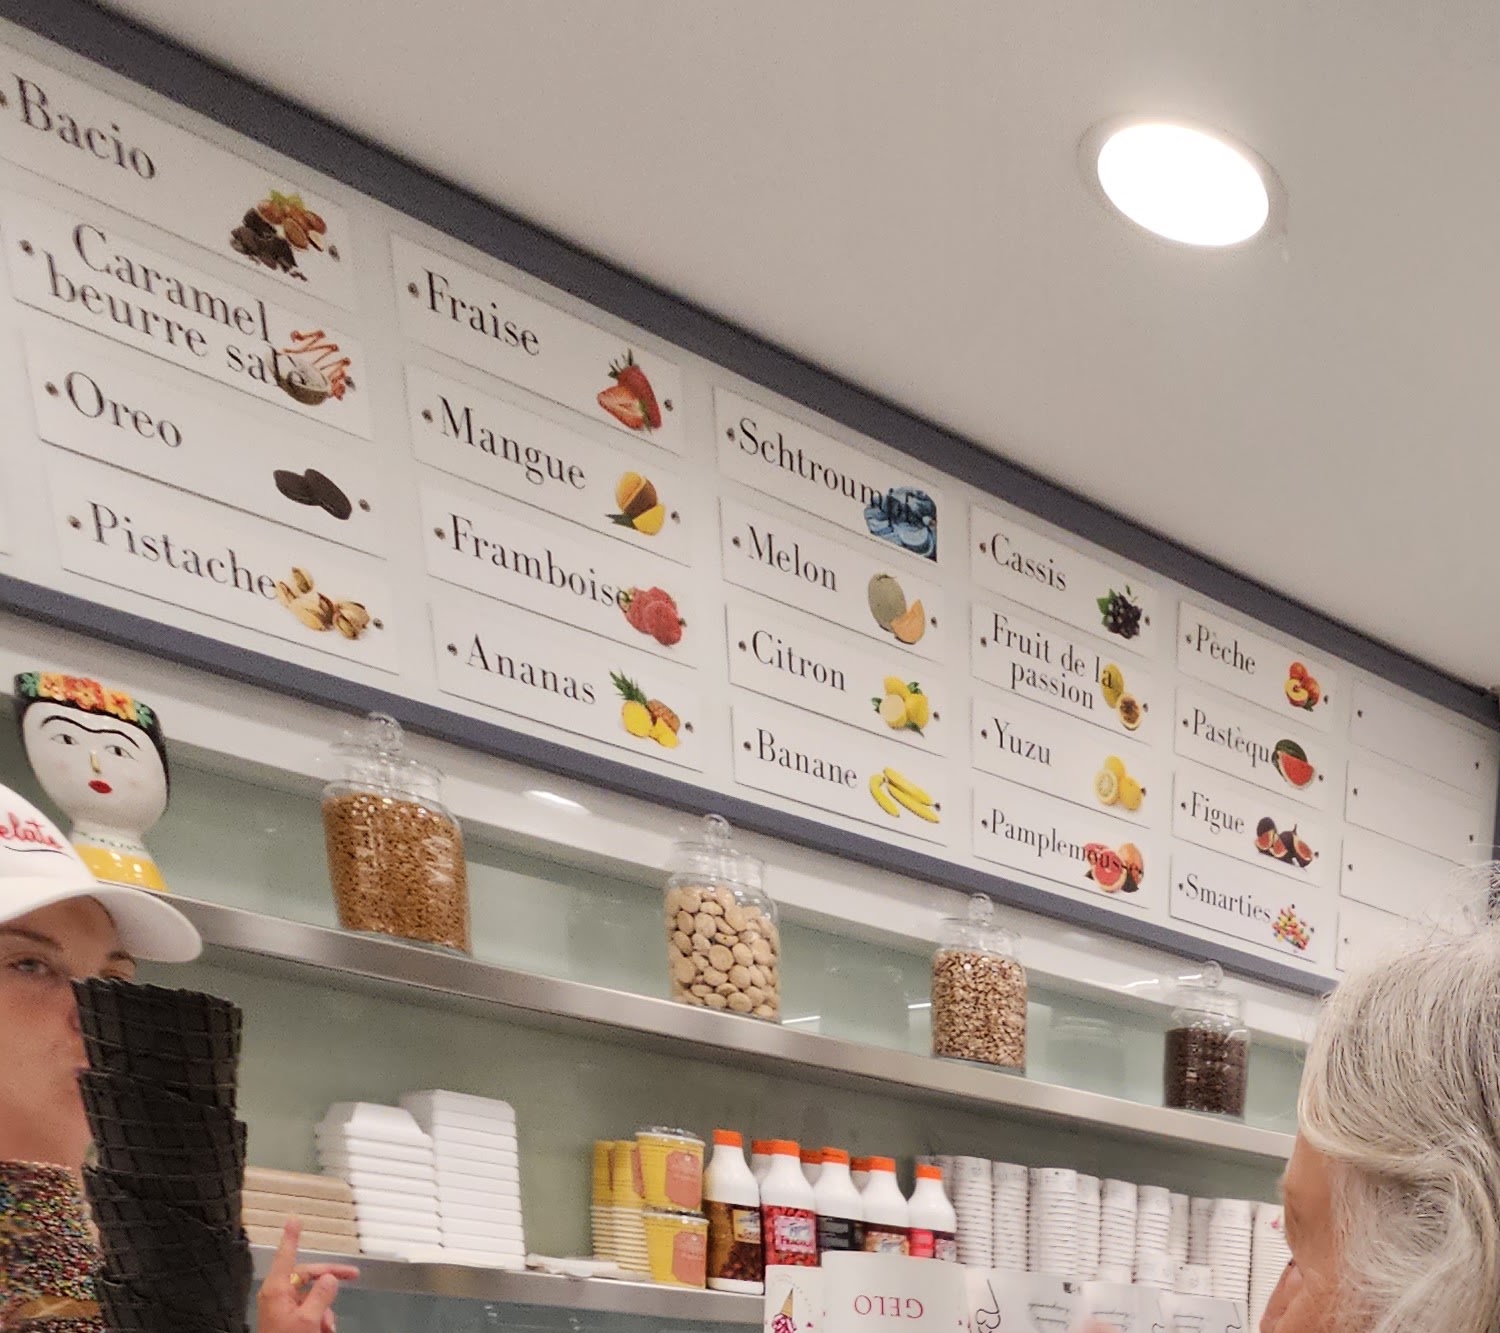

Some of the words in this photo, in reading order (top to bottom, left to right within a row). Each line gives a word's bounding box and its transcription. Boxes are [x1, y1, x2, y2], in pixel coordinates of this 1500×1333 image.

[11, 72, 156, 181] Bacio
[45, 249, 208, 357] beurre
[72, 223, 270, 341] Caramel
[422, 267, 540, 356] Fraise
[64, 371, 183, 448] Oreo
[437, 395, 586, 490] Mangue
[87, 500, 279, 600] Pistache
[449, 512, 632, 612] Framboise
[747, 524, 838, 592] Melon
[991, 533, 1067, 592] Cassis
[465, 633, 597, 705] Ananas
[752, 630, 847, 692] Citron
[993, 612, 1052, 664] Fruit
[1061, 645, 1085, 677] de
[1095, 656, 1113, 690] la
[1011, 661, 1095, 711] passion
[756, 728, 858, 789] Banane
[993, 718, 1052, 767] Yuzu
[1193, 707, 1275, 768] Pastèqu
[1191, 791, 1245, 835] Figue
[1186, 873, 1272, 923] Smarties
[854, 1294, 924, 1320] GELO
